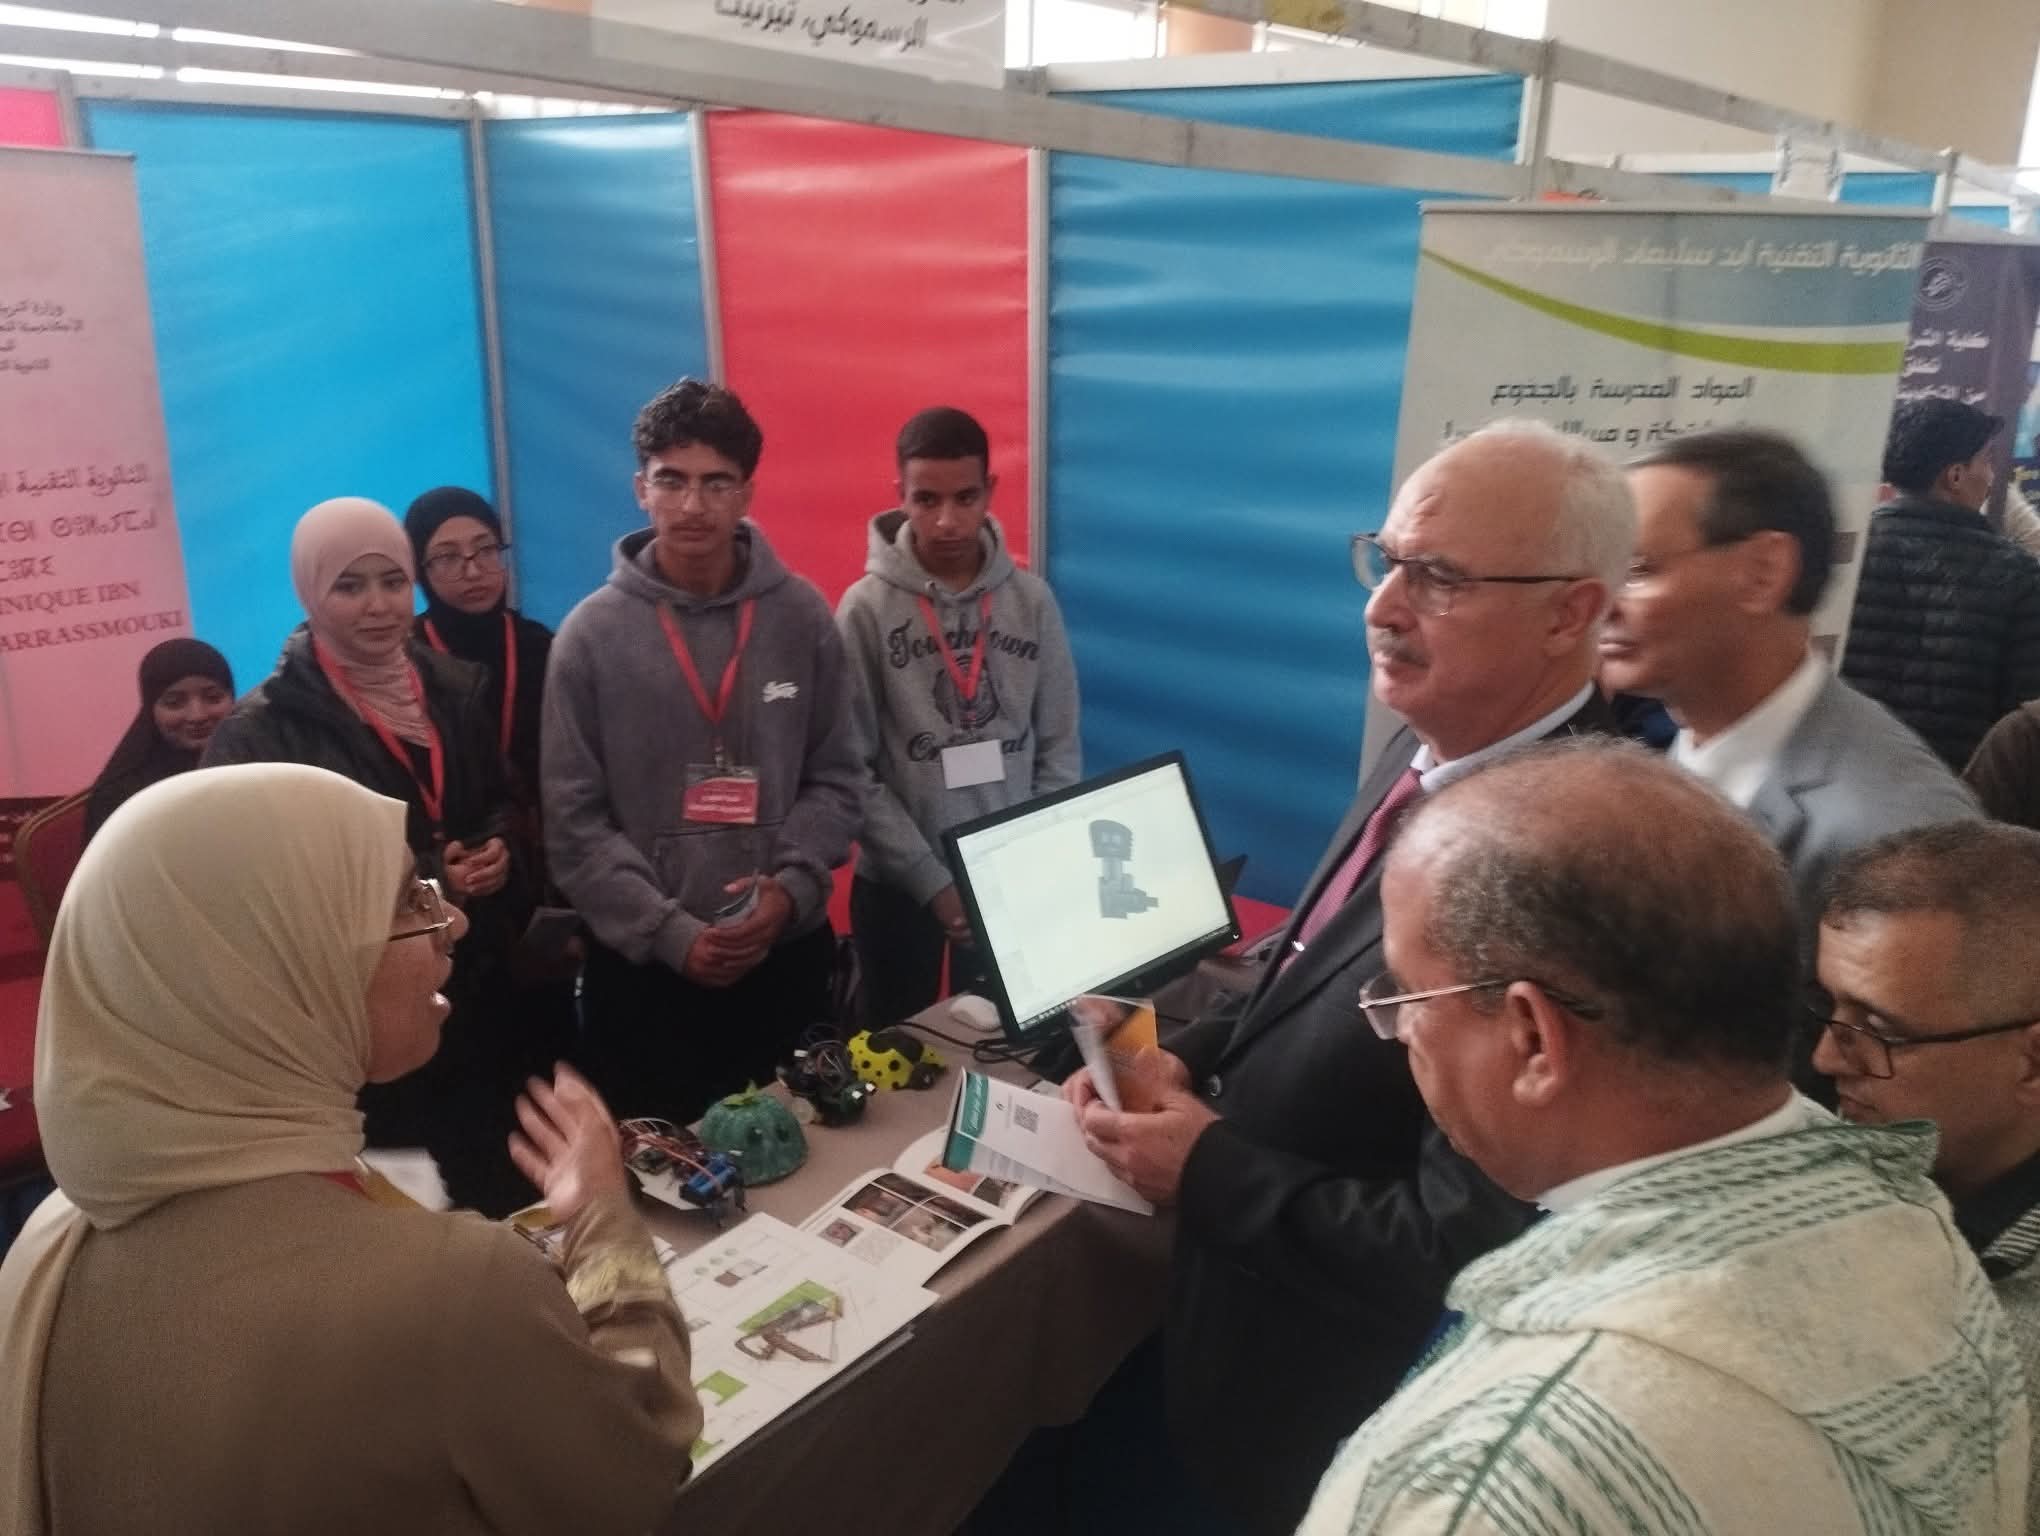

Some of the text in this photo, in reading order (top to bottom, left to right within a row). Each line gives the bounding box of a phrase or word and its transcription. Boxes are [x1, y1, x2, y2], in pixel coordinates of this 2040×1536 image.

[1691, 375, 1757, 405] المواد
[16, 467, 80, 497] التقنية
[87, 463, 149, 497] الثانوية
[97, 580, 142, 602] IBN
[887, 613, 1041, 669] Touchown
